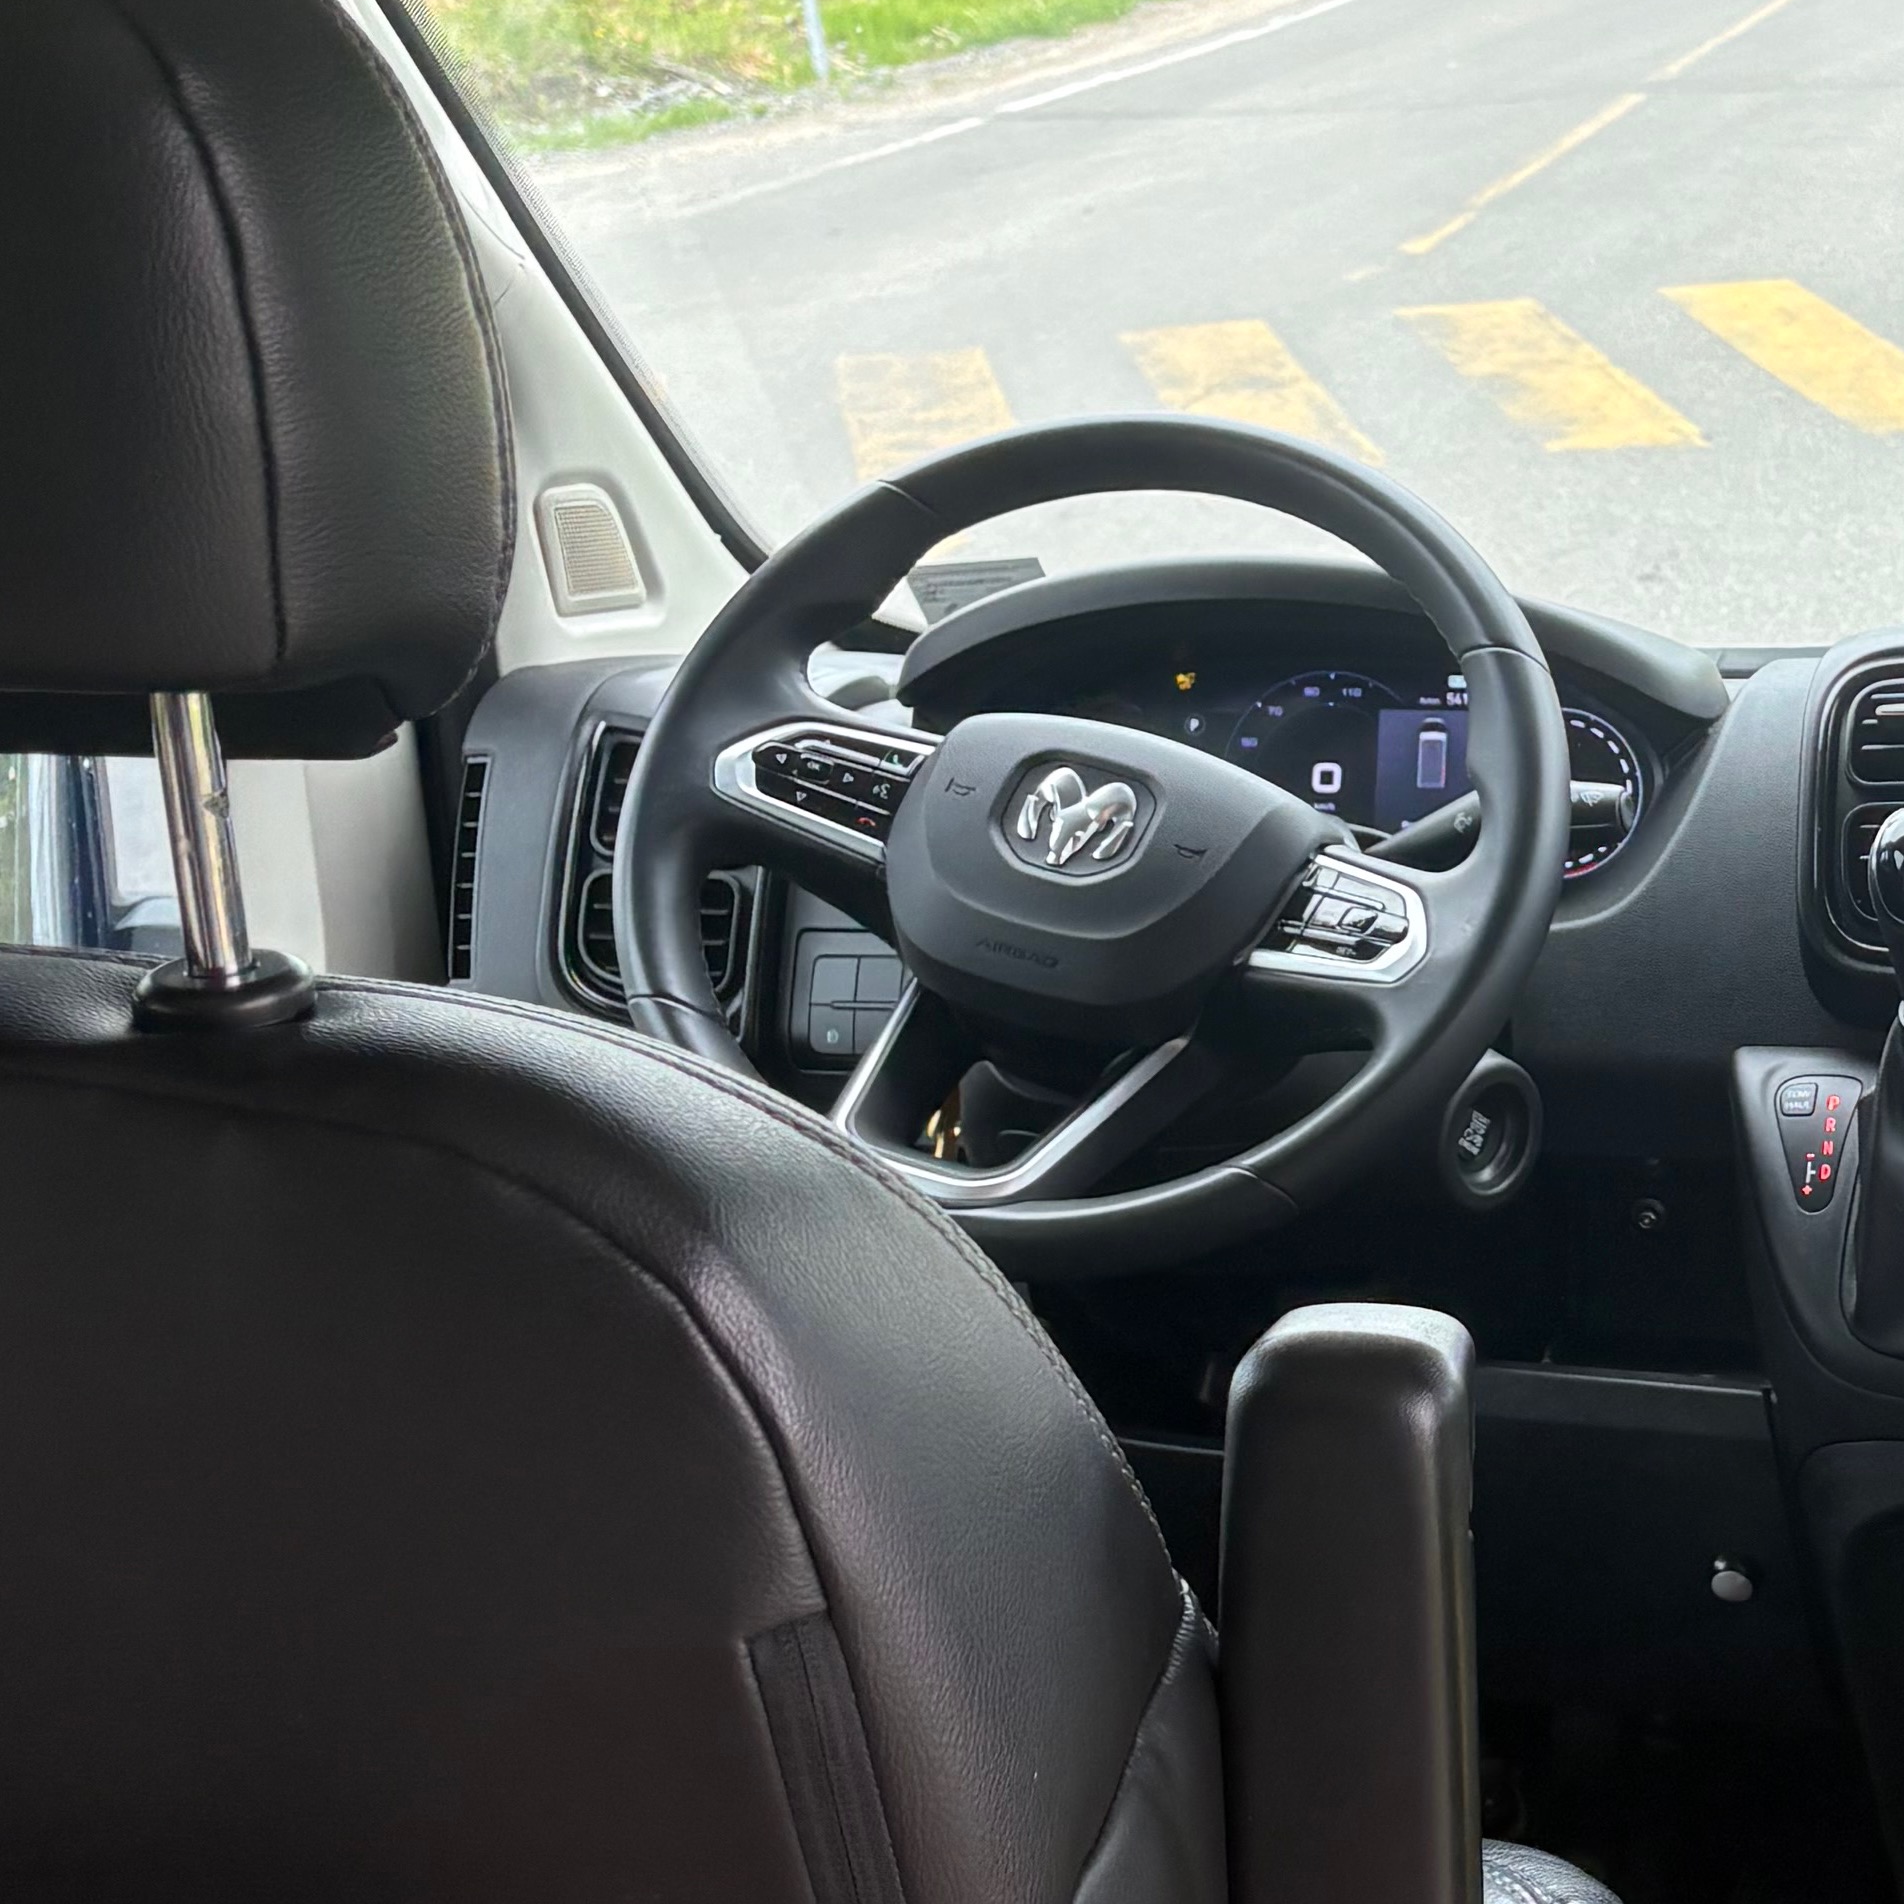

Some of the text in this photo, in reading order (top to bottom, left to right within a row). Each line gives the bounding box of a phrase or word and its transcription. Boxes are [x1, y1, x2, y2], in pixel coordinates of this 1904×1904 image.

[1826, 1095, 1841, 1111] P
[1825, 1117, 1837, 1132] R
[1822, 1140, 1834, 1156] N
[1819, 1163, 1832, 1180] D
